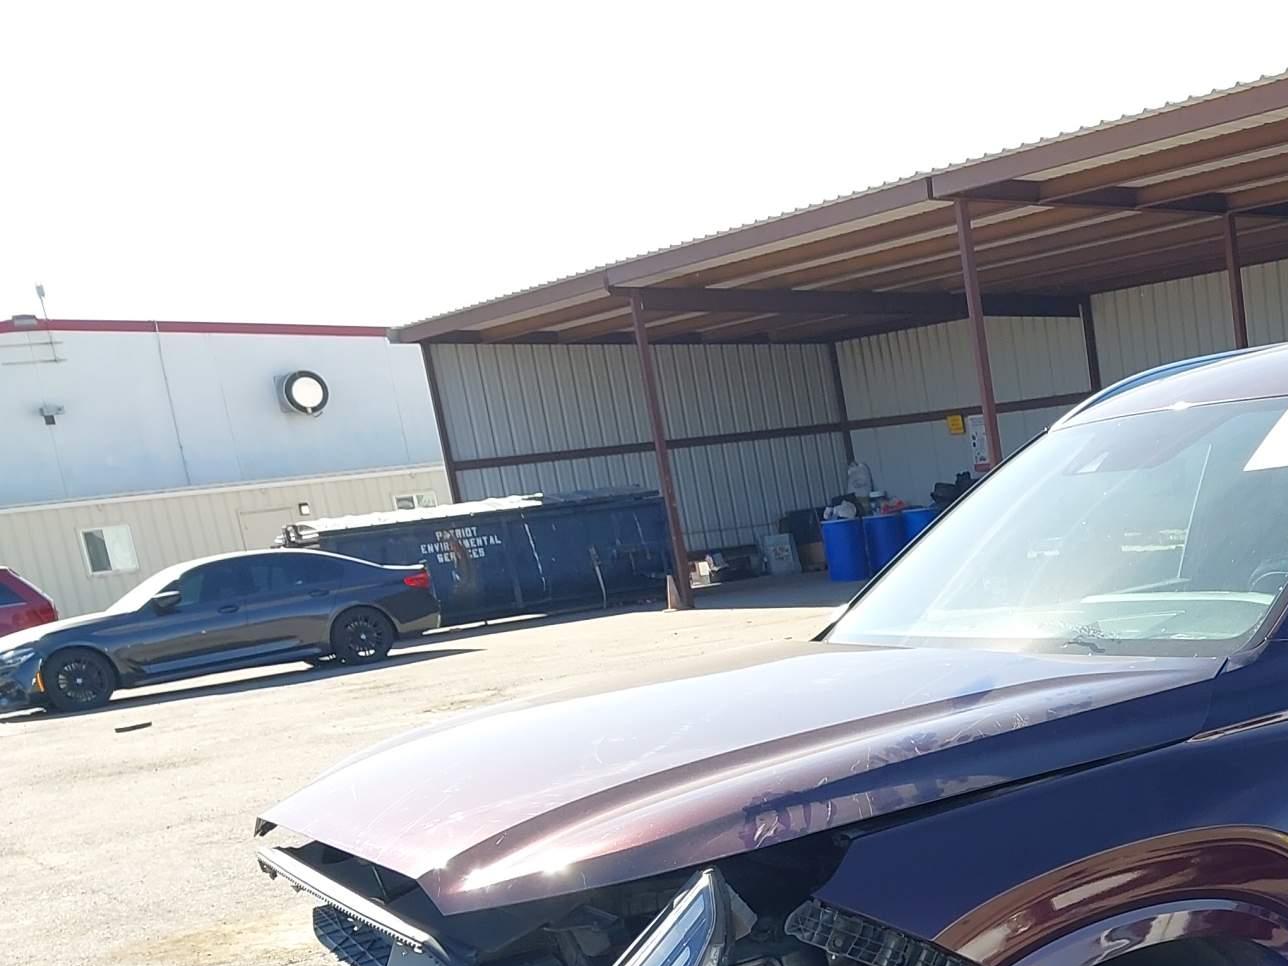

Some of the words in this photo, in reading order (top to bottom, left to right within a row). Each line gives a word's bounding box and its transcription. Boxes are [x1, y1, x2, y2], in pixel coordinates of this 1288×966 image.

[435, 526, 477, 542] PATRIOT
[420, 534, 502, 554] ENVIRMENTAL
[436, 547, 485, 563] SERCES
